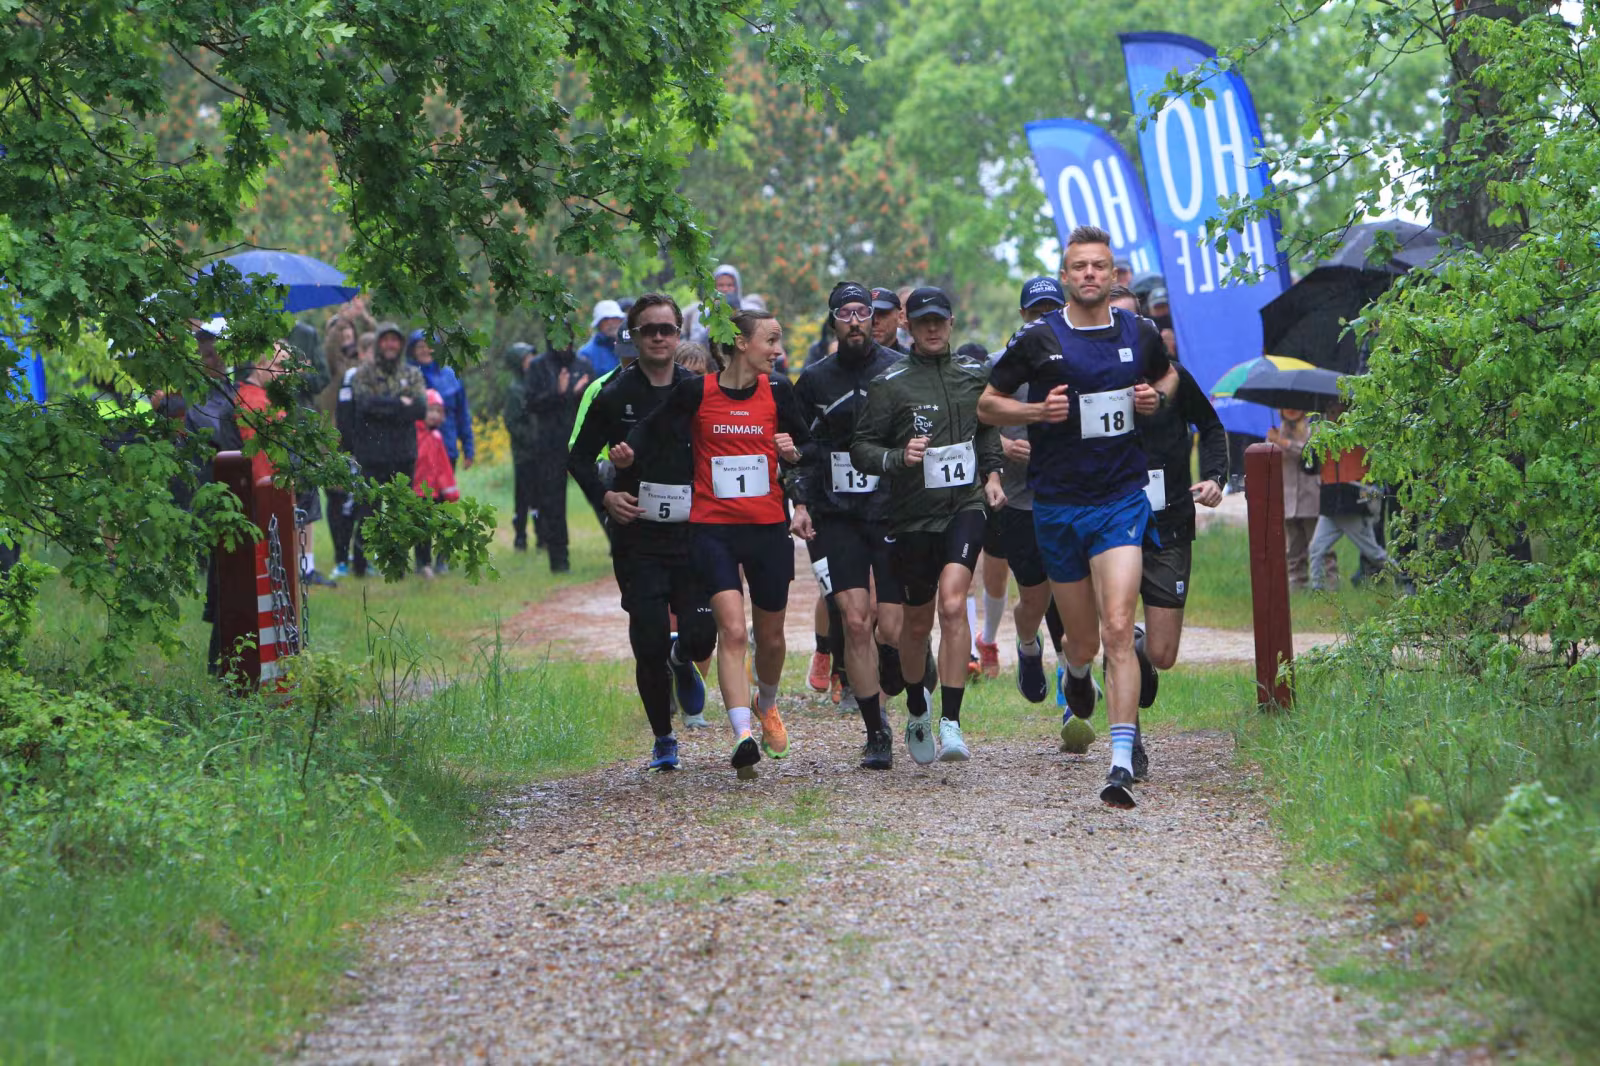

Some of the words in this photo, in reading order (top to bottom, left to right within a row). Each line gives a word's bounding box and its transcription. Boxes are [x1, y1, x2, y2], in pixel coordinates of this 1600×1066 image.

[713, 424, 763, 435] DENMARK
[1100, 410, 1124, 433] 18
[845, 470, 868, 489] 13
[941, 462, 965, 483] 14
[736, 474, 746, 493] 1
[658, 502, 671, 519] 5
[961, 543, 969, 558] FUSION
